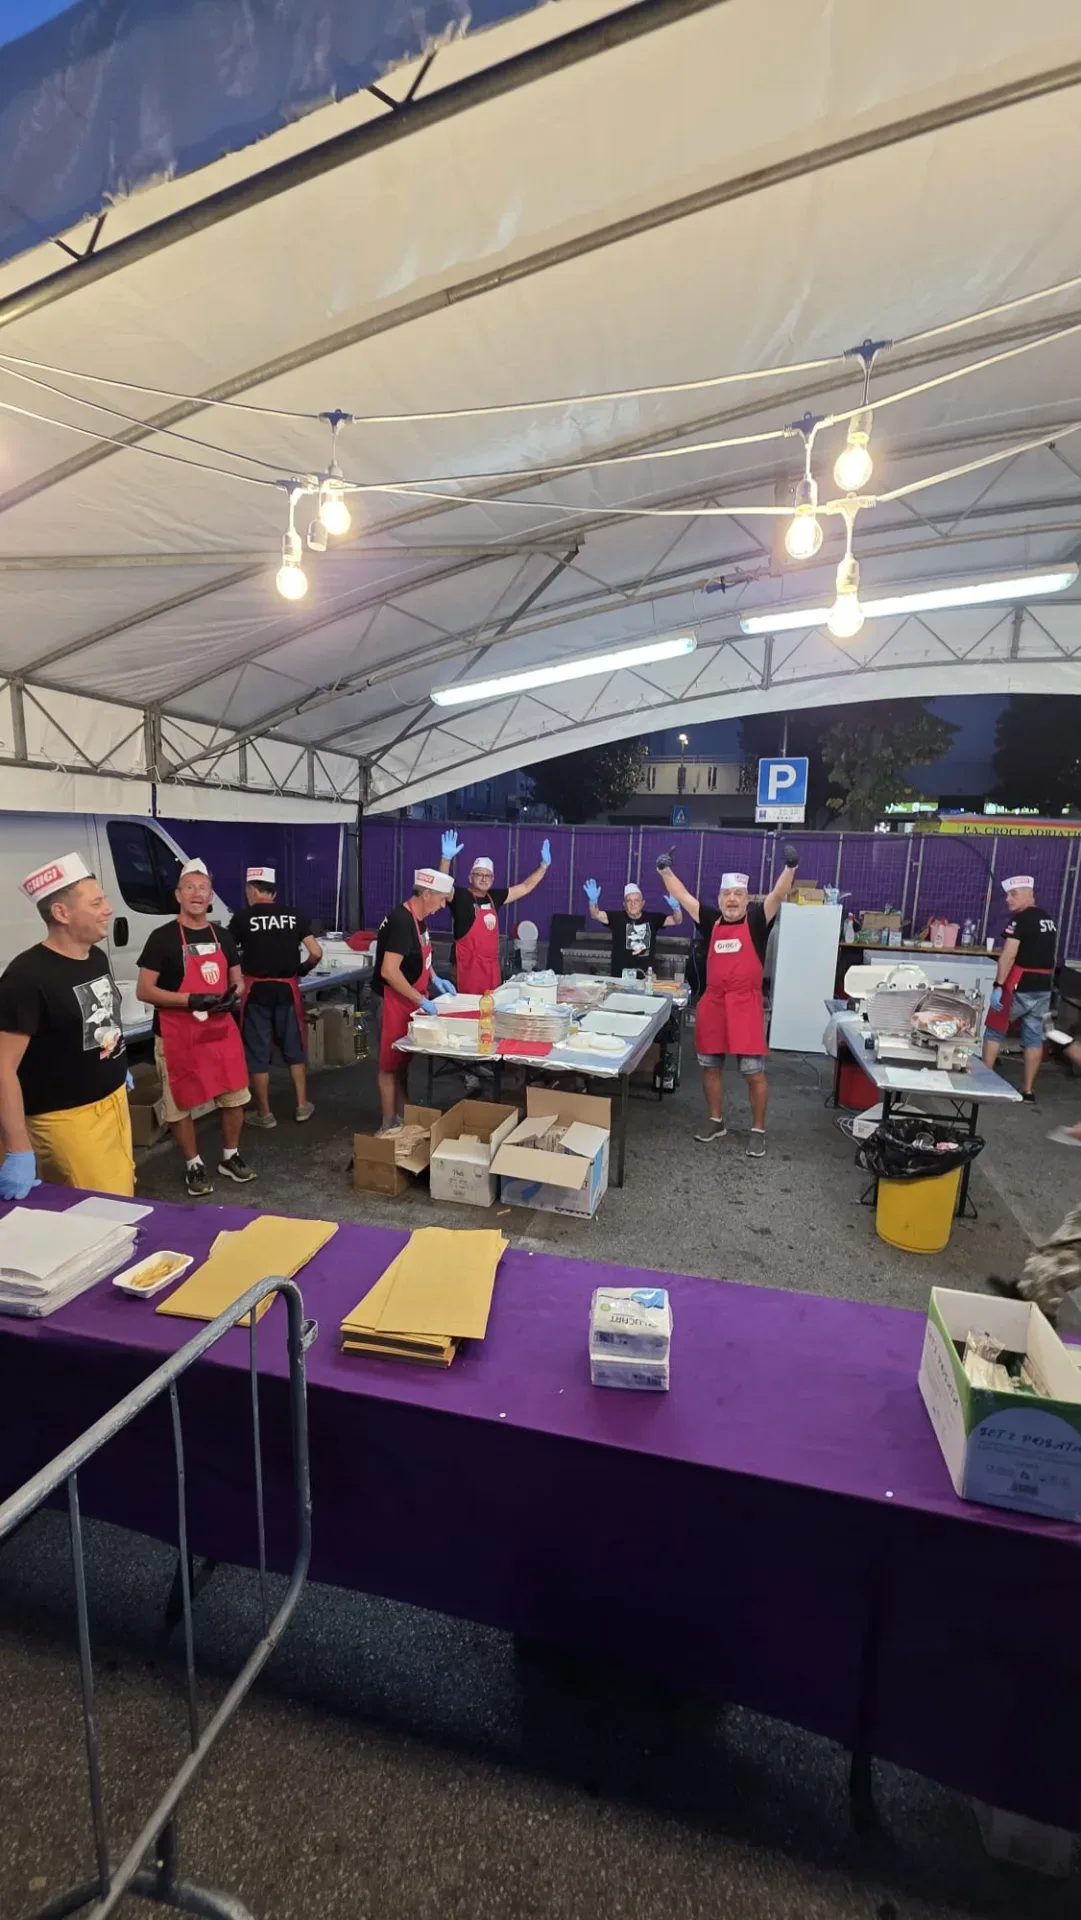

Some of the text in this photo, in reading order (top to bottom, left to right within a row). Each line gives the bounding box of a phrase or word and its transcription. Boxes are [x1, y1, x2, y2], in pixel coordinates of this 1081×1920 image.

[768, 764, 797, 800] P
[984, 826, 1025, 837] CROCE
[249, 914, 297, 932] STAFF
